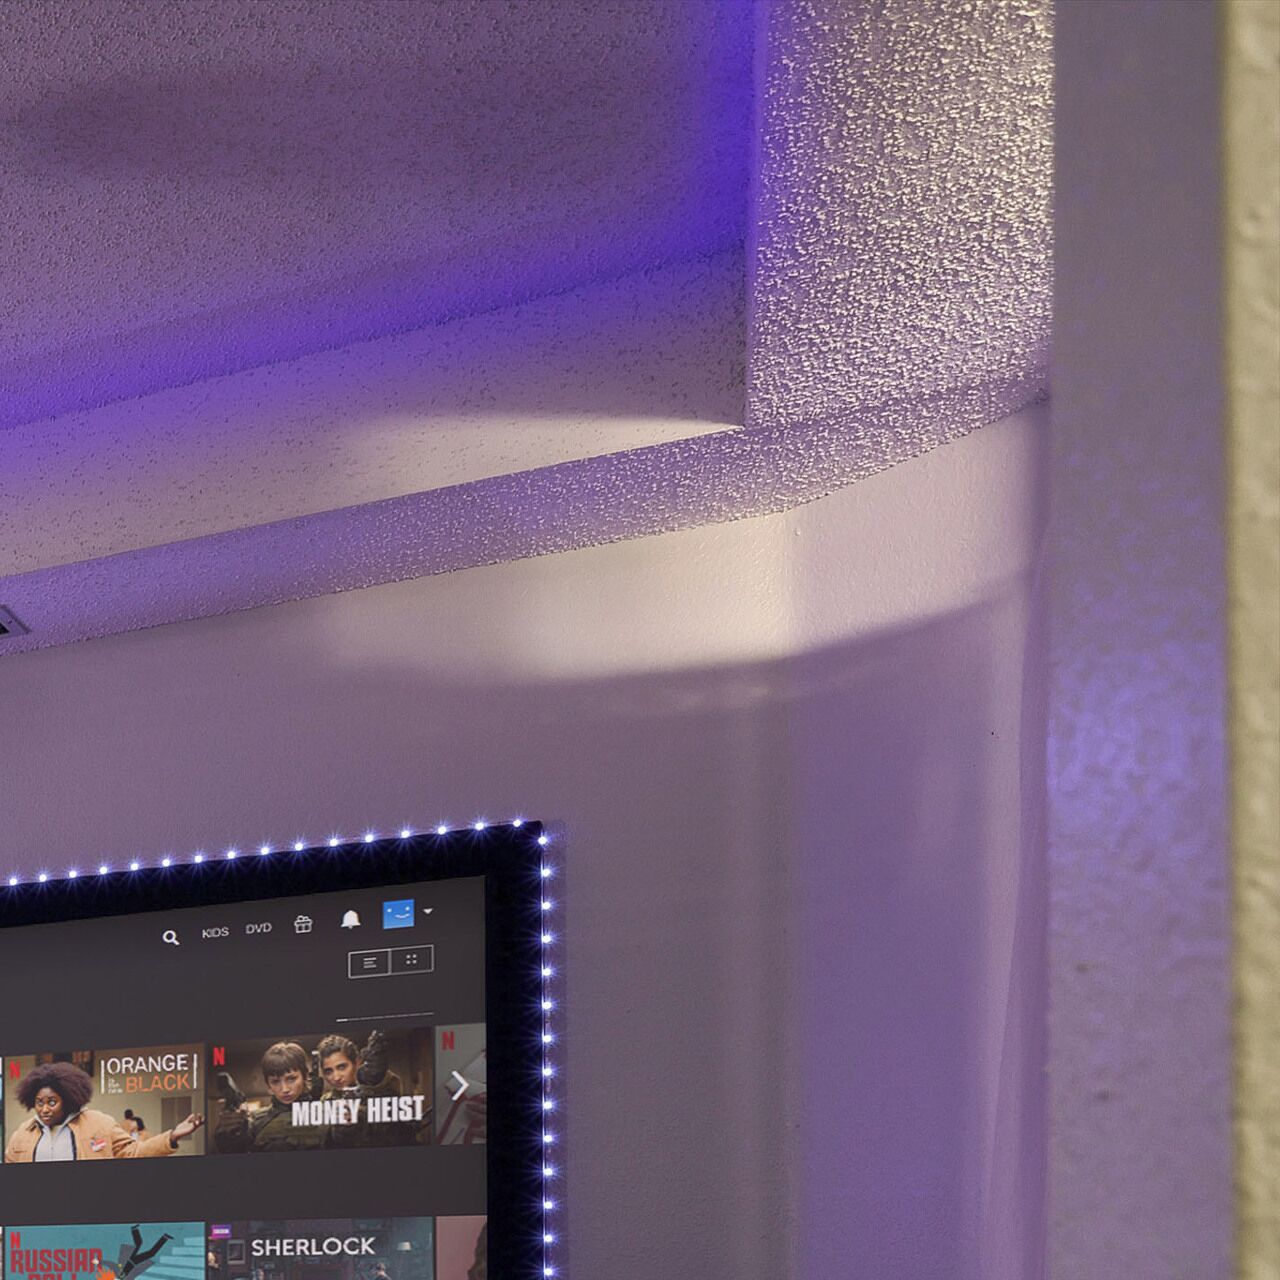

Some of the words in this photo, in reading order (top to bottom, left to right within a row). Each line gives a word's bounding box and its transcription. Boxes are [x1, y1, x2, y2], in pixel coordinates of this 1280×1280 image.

[202, 926, 229, 939] KIDS
[246, 922, 272, 934] DVD
[107, 1054, 189, 1075] ORANGE
[126, 1073, 191, 1093] BLACK
[292, 1098, 361, 1127] MONEY
[367, 1095, 424, 1122] HEIST
[251, 1236, 376, 1256] SHERLOCK
[10, 1248, 103, 1275] RUSSIAN
